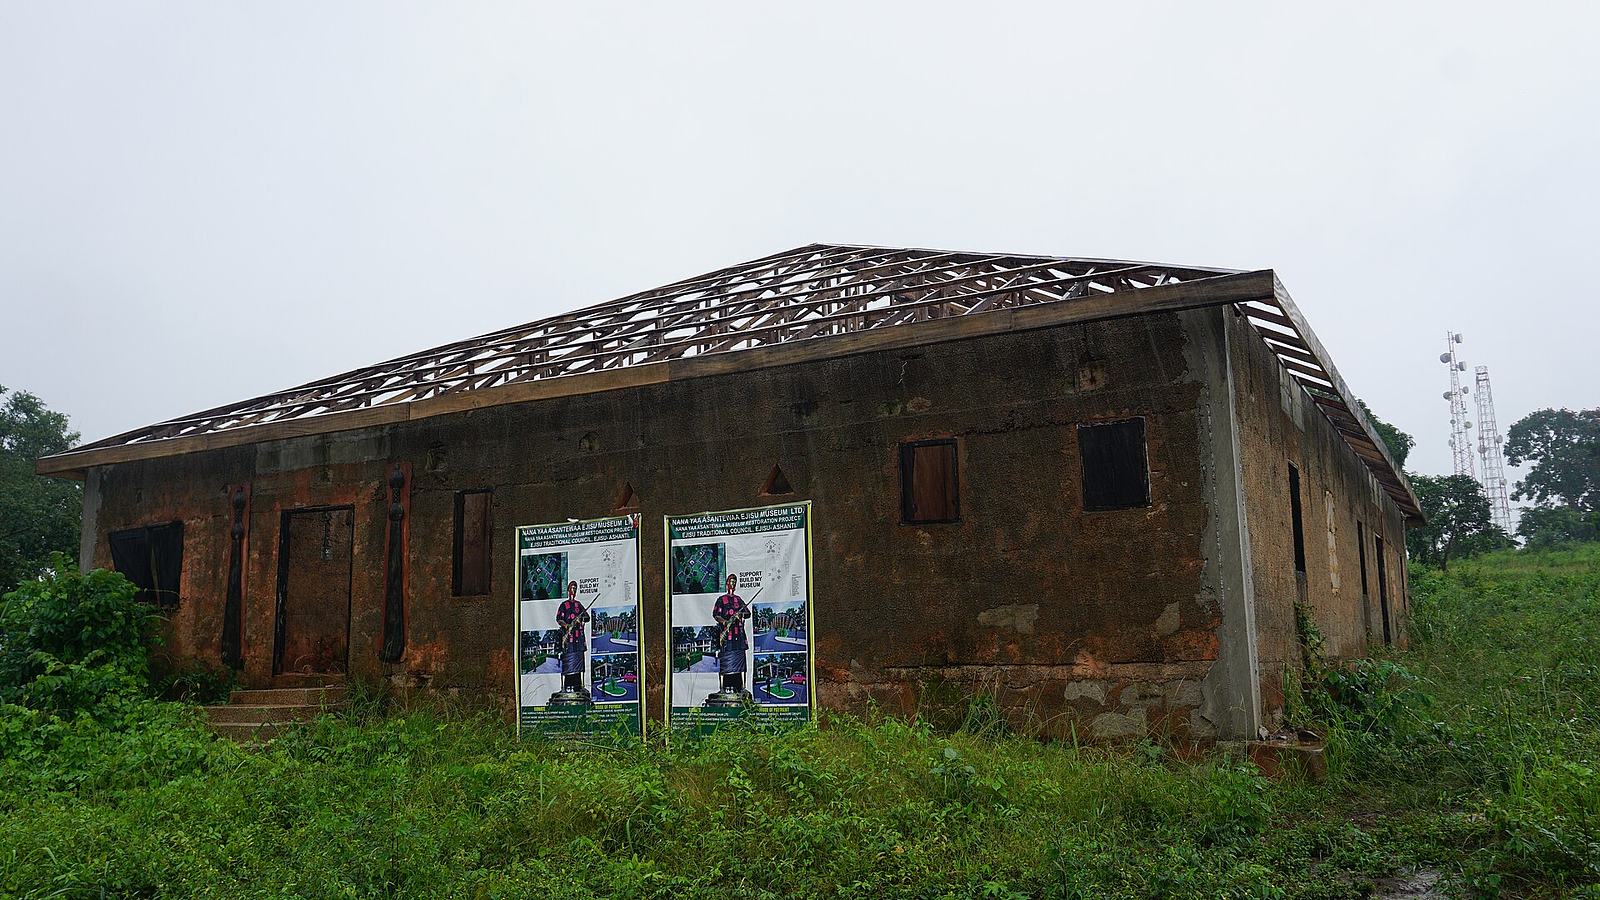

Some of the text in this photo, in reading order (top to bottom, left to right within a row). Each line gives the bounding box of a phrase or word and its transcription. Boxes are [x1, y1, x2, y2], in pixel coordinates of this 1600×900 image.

[597, 519, 623, 529] MUSEUM
[672, 518, 689, 526] NANA
[741, 512, 759, 520] EJISU
[760, 508, 788, 518] MUSEUM
